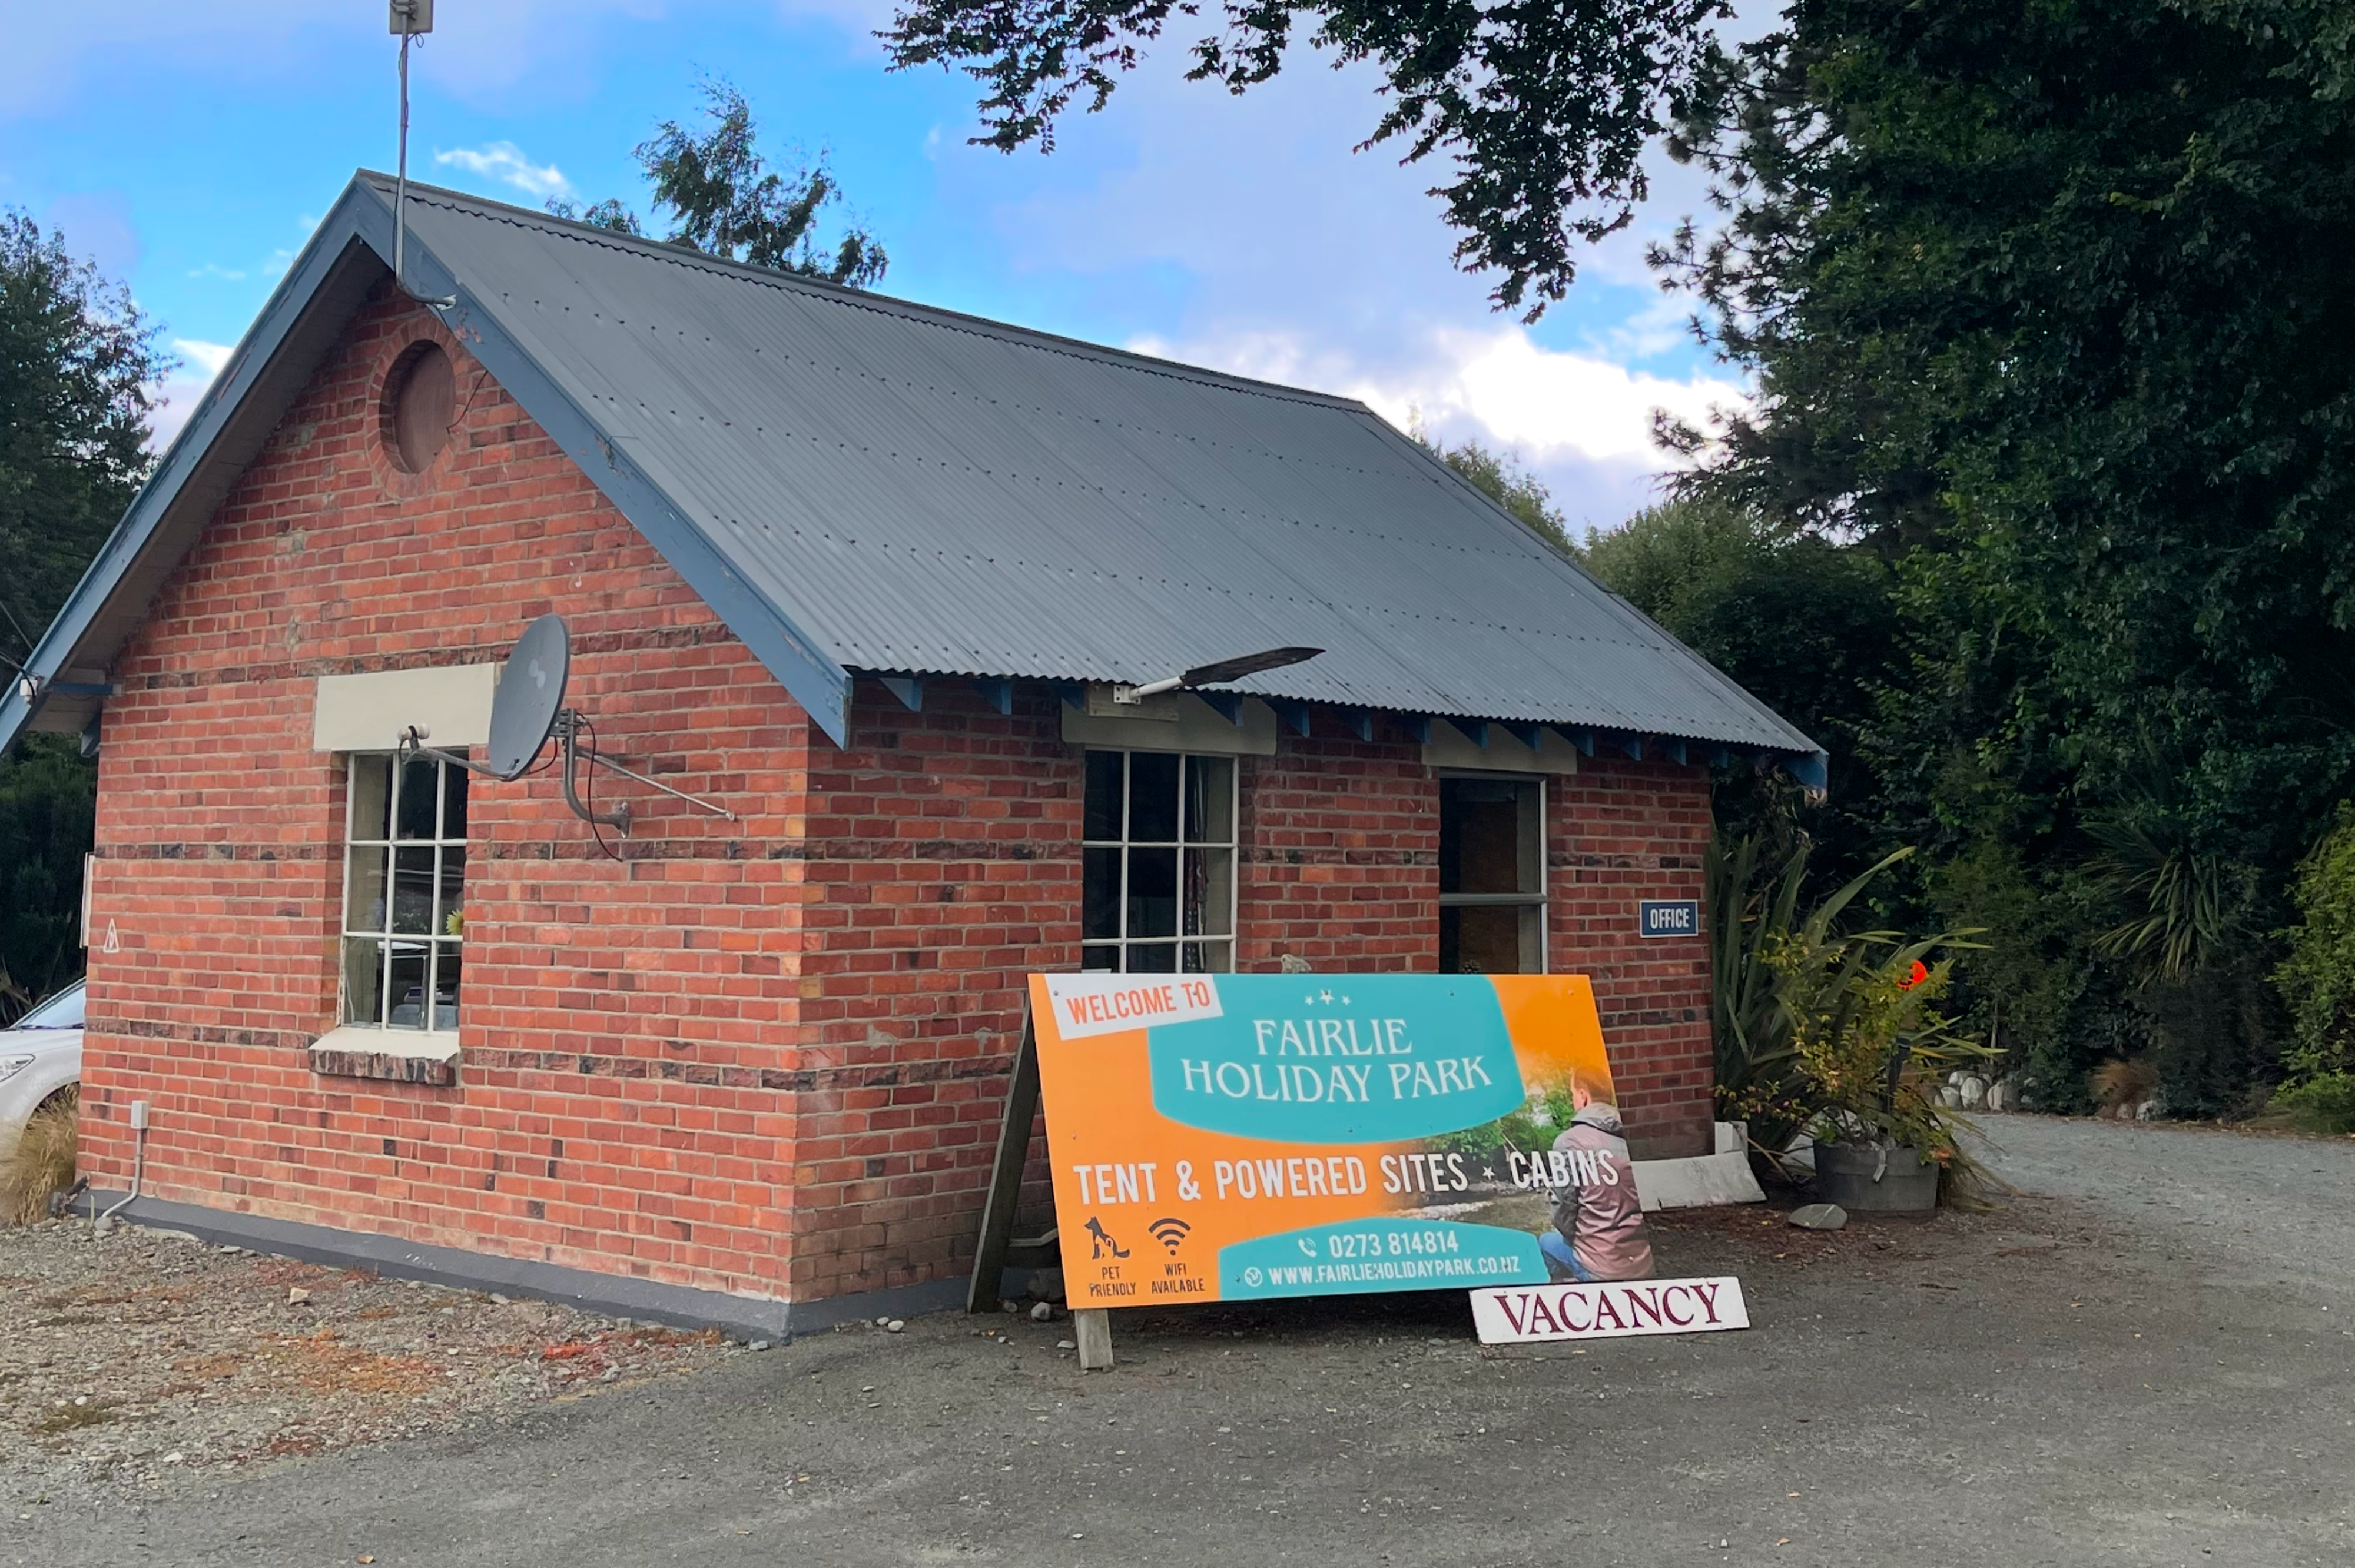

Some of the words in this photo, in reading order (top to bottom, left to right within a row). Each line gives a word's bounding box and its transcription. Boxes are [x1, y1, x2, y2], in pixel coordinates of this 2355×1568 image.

[1650, 908, 1690, 929] OFFICE
[1066, 985, 1177, 1024] WELCOME
[1181, 981, 1210, 1008] TO
[1252, 1019, 1412, 1055] FAIRLIE
[1181, 1059, 1373, 1102] HOLIDAY
[1387, 1055, 1492, 1099] PARK
[1073, 1162, 1157, 1205] TENT
[1176, 1160, 1202, 1201] &
[1213, 1156, 1368, 1200] POWERED
[1379, 1152, 1468, 1194] SITES
[1509, 1149, 1620, 1189] CABINS
[1329, 1234, 1382, 1258] 0273
[1389, 1230, 1459, 1255] 814814
[1102, 1267, 1120, 1280] PET
[1164, 1263, 1187, 1276] WIFI
[1268, 1255, 1521, 1286] WWW.FAIRLIEHOLIDAYPARK.CO.NZ
[1151, 1278, 1205, 1294] AVAILABLE
[1493, 1283, 1722, 1336] VACANCY
